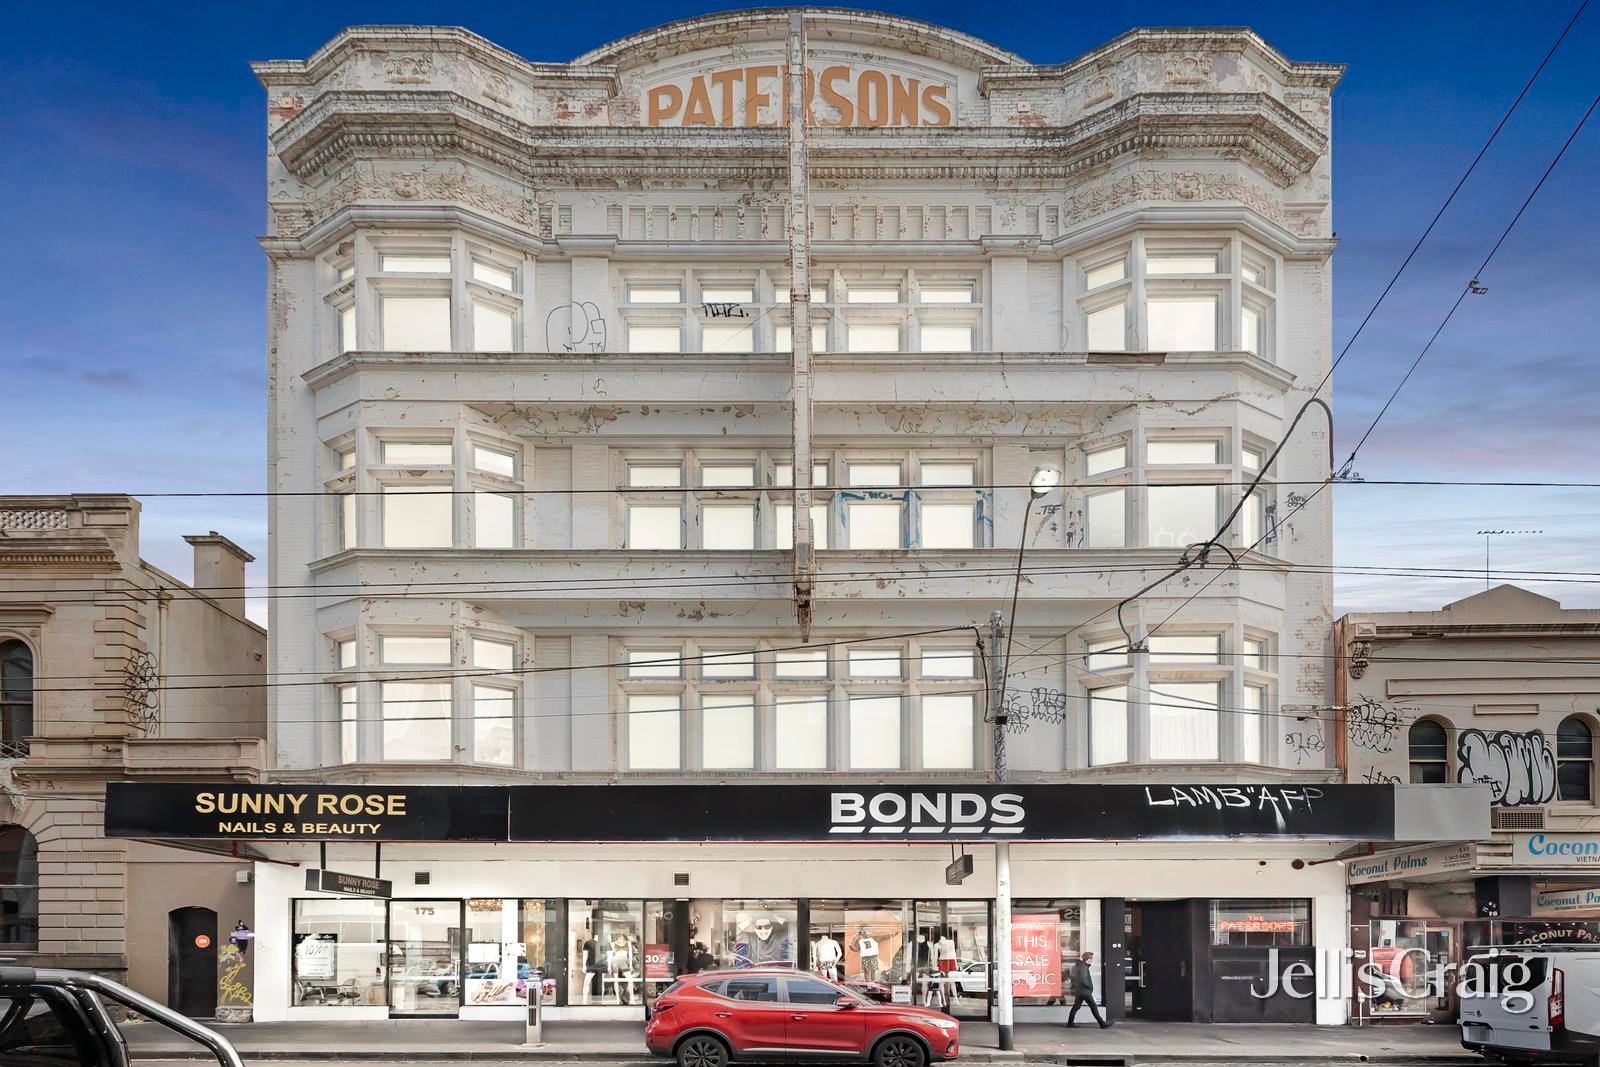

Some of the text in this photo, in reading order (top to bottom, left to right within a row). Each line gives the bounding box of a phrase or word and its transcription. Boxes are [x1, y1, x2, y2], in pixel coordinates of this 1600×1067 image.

[647, 64, 953, 127] PATERSONS
[194, 792, 408, 817] SUNNY ROSE
[830, 792, 1026, 824] BONDS
[218, 822, 381, 835] NAILS & BEAUTY
[1349, 861, 1388, 877] Coconut
[1393, 855, 1428, 871] Palms
[337, 875, 380, 890] SUNNY ROSE
[1536, 894, 1580, 907] Coconut
[415, 906, 435, 915] 175
[1015, 935, 1048, 948] THIS
[1576, 928, 1600, 943] PAL
[1014, 954, 1050, 967] SALE
[1025, 973, 1056, 986] EPIC
